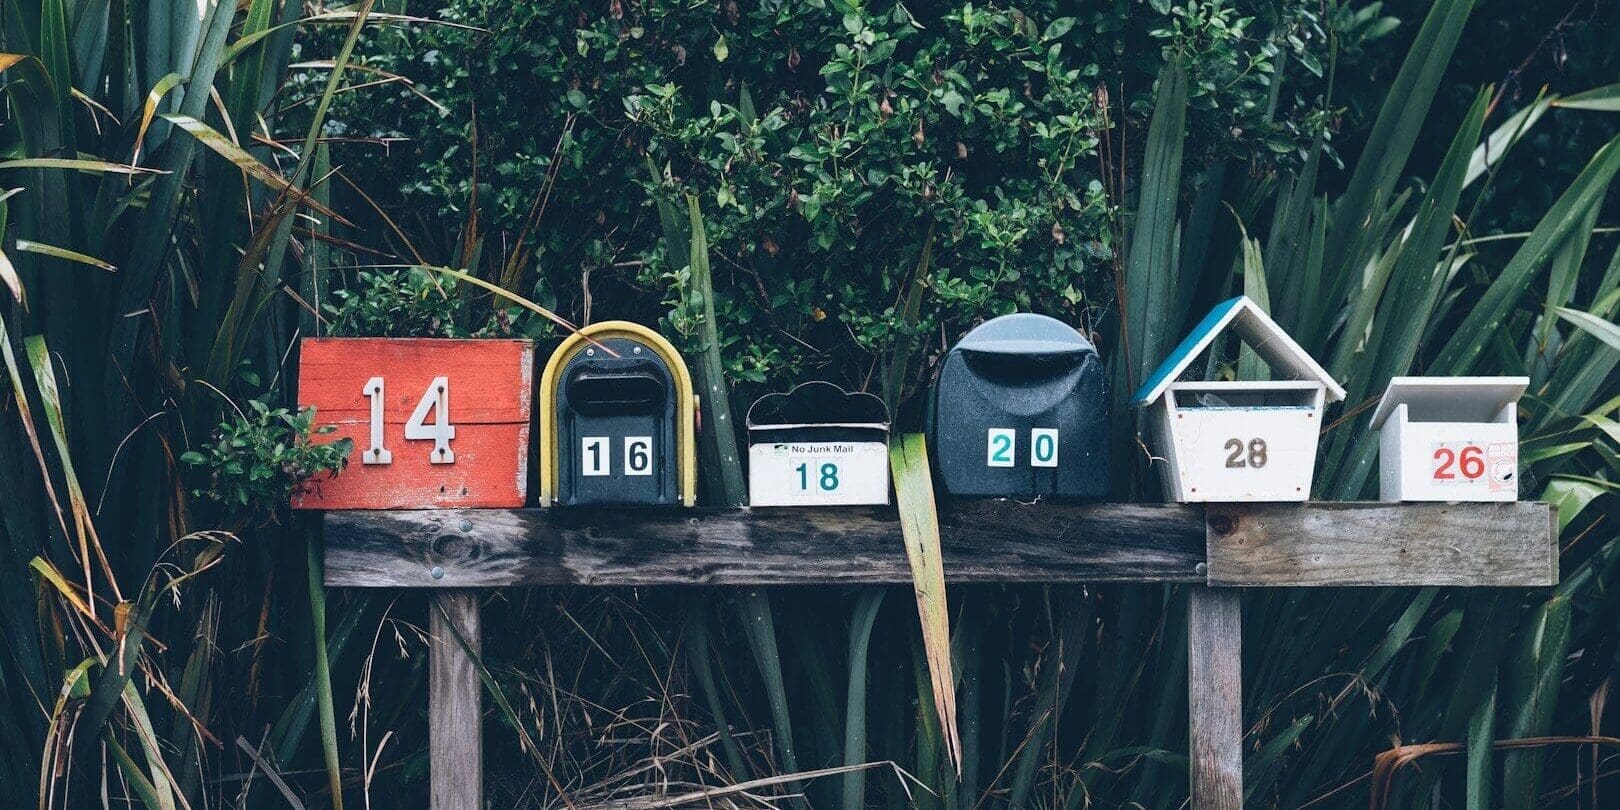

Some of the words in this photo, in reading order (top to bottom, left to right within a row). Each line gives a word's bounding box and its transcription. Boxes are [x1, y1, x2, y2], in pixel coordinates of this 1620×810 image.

[362, 376, 456, 464] 14
[587, 441, 648, 472] 16
[791, 445, 806, 453] No
[808, 445, 831, 453] Junk
[834, 445, 854, 453] Mail
[991, 434, 1054, 462] 20
[1224, 437, 1268, 469] 28
[1433, 446, 1485, 479] 26
[796, 462, 839, 491] 18
